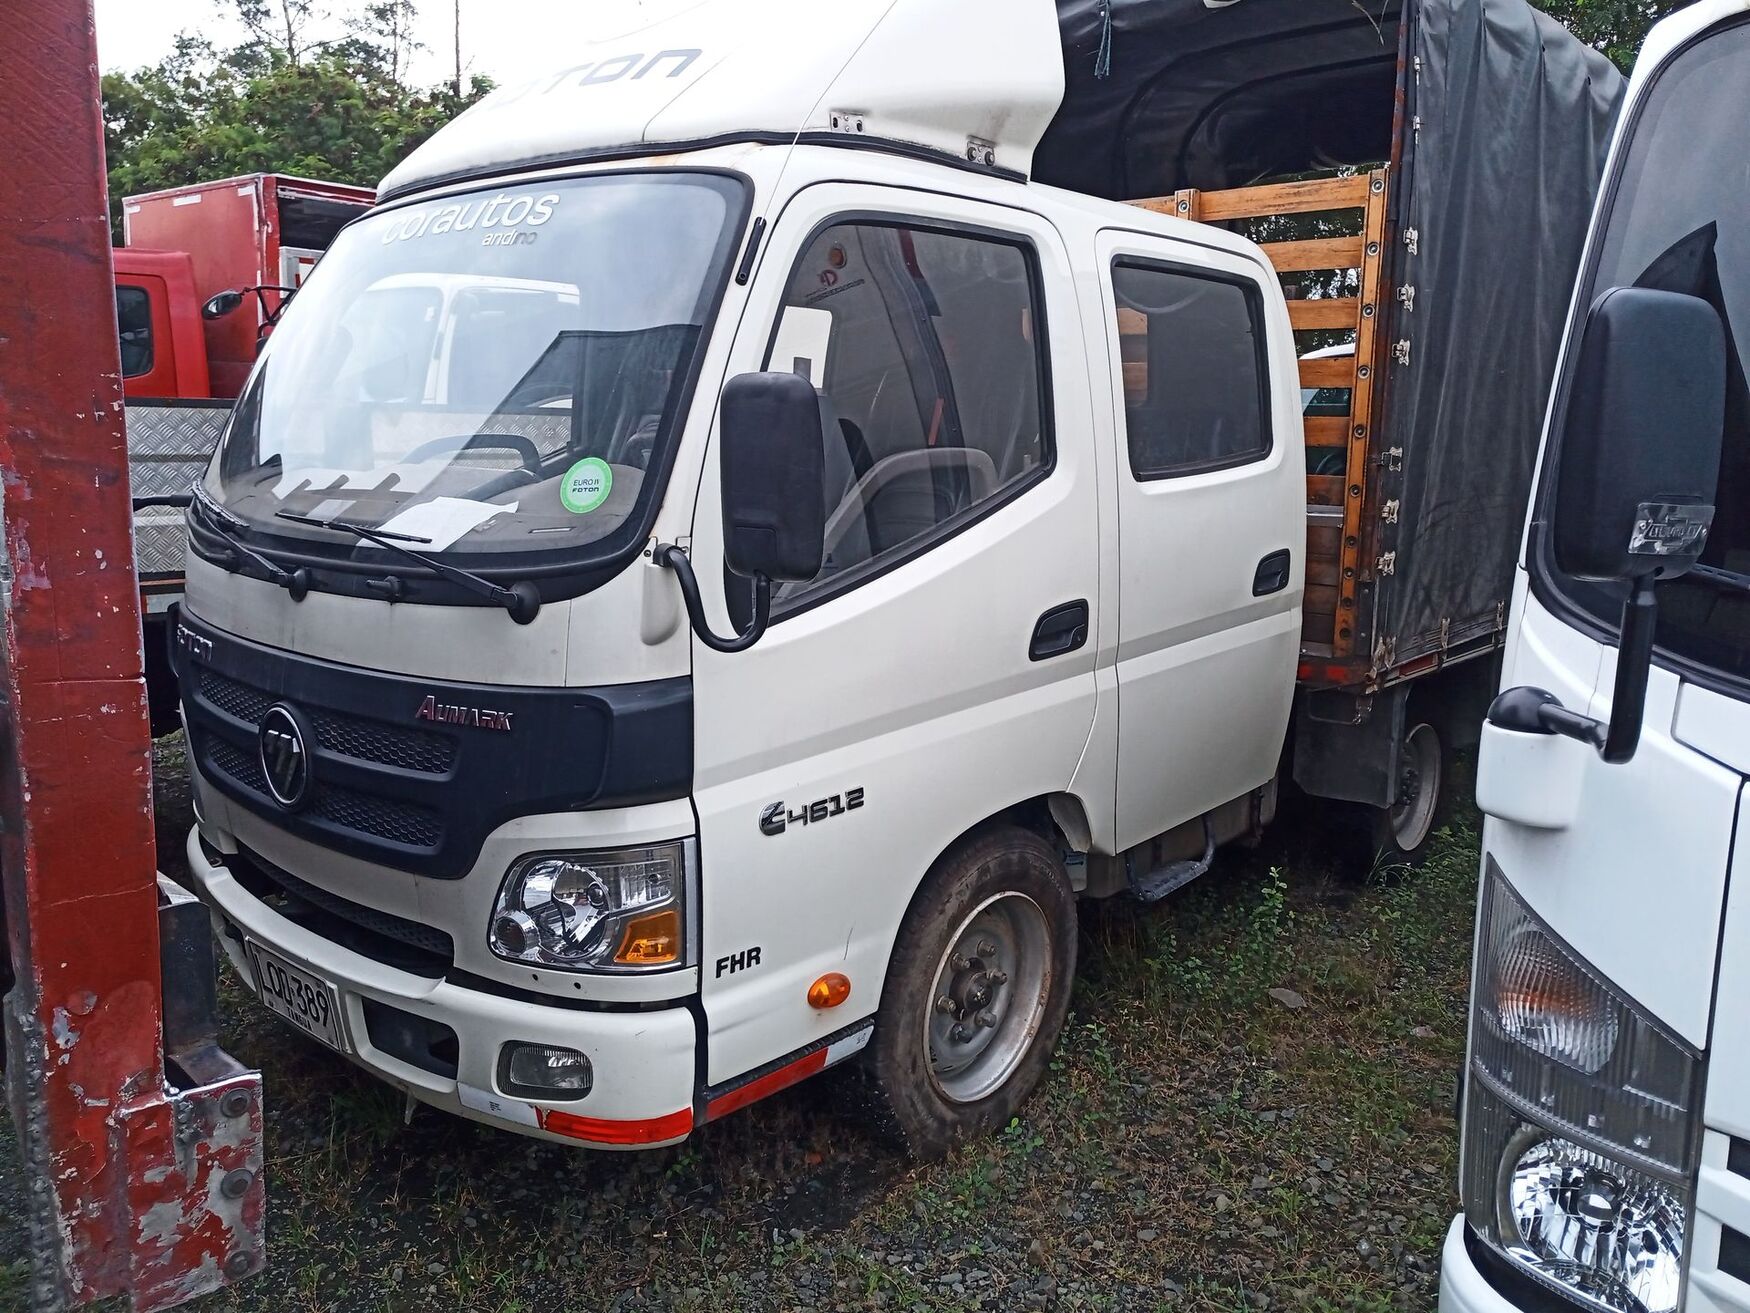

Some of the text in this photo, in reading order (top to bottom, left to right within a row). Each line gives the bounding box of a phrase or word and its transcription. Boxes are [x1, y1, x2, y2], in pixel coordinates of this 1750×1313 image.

[381, 192, 561, 246] corautos
[481, 230, 538, 247] andino
[573, 478, 593, 487] EURO
[715, 946, 762, 979] FHR
